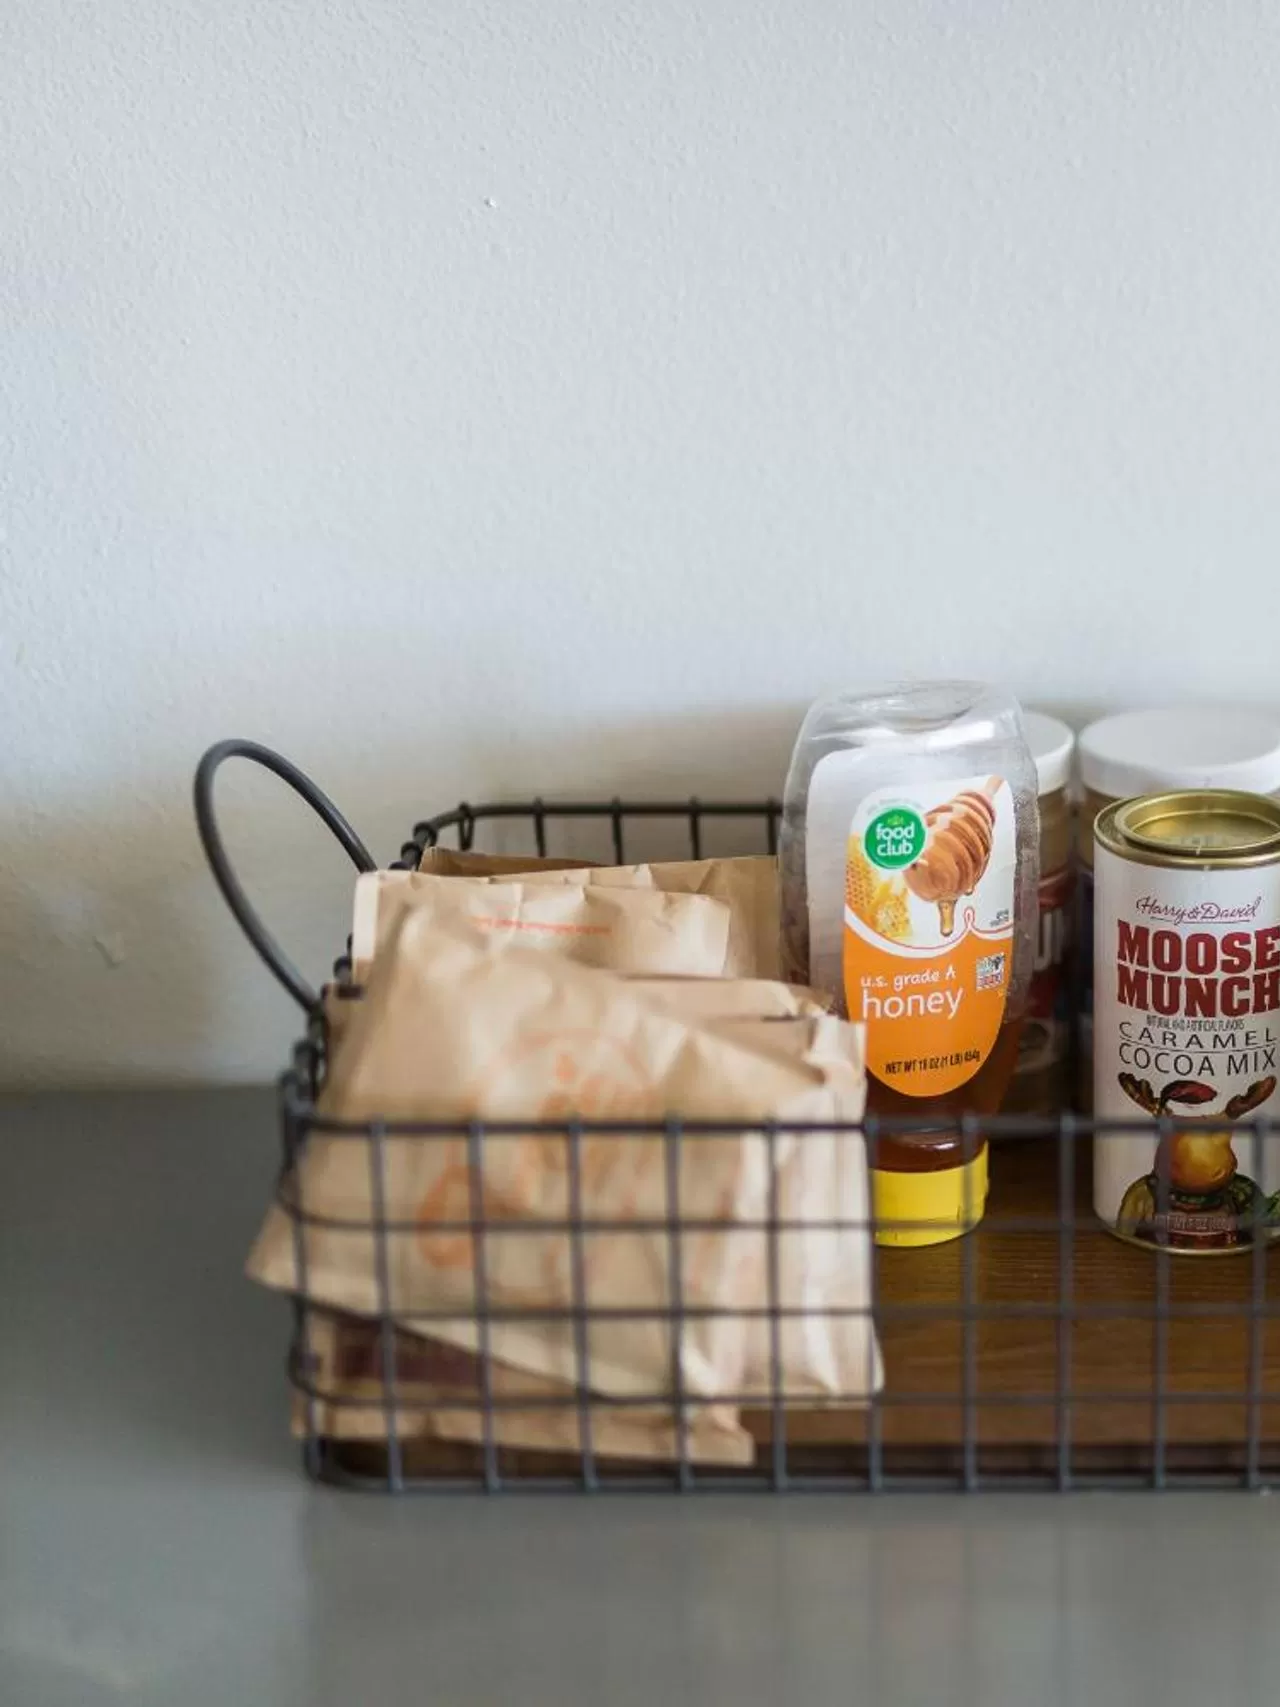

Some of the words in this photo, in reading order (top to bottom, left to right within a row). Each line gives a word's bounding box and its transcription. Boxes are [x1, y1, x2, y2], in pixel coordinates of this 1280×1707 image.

[875, 821, 915, 841] food
[876, 839, 914, 857] club
[893, 968, 941, 993] grade
[945, 964, 957, 980] A
[1117, 964, 1280, 1018] MUNCH
[862, 986, 964, 1020] honey
[1119, 1021, 1277, 1049] CARAMEL
[1119, 1042, 1215, 1076] COCOA
[1227, 1047, 1276, 1076] MIX
